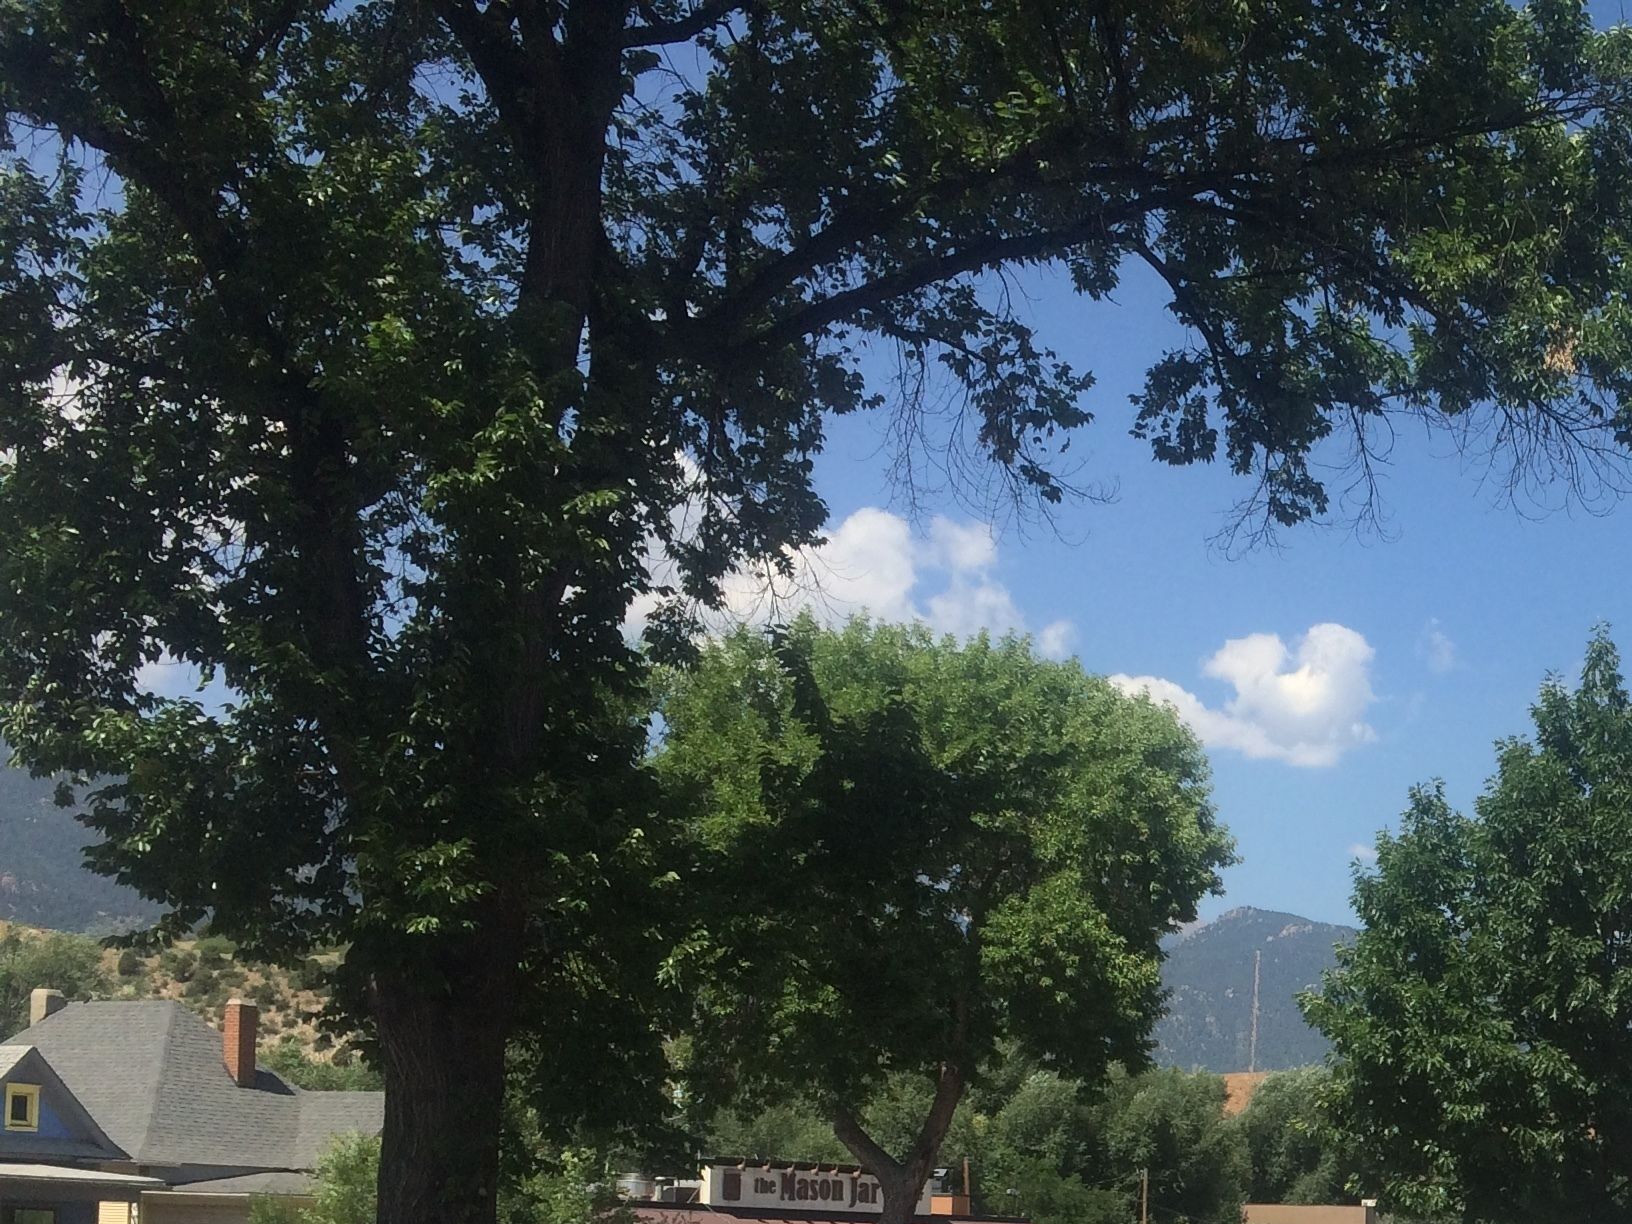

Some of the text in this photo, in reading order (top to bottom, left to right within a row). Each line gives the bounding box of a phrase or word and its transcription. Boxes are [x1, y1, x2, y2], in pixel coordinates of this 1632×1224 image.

[754, 1172, 881, 1208] the Mason Jar
